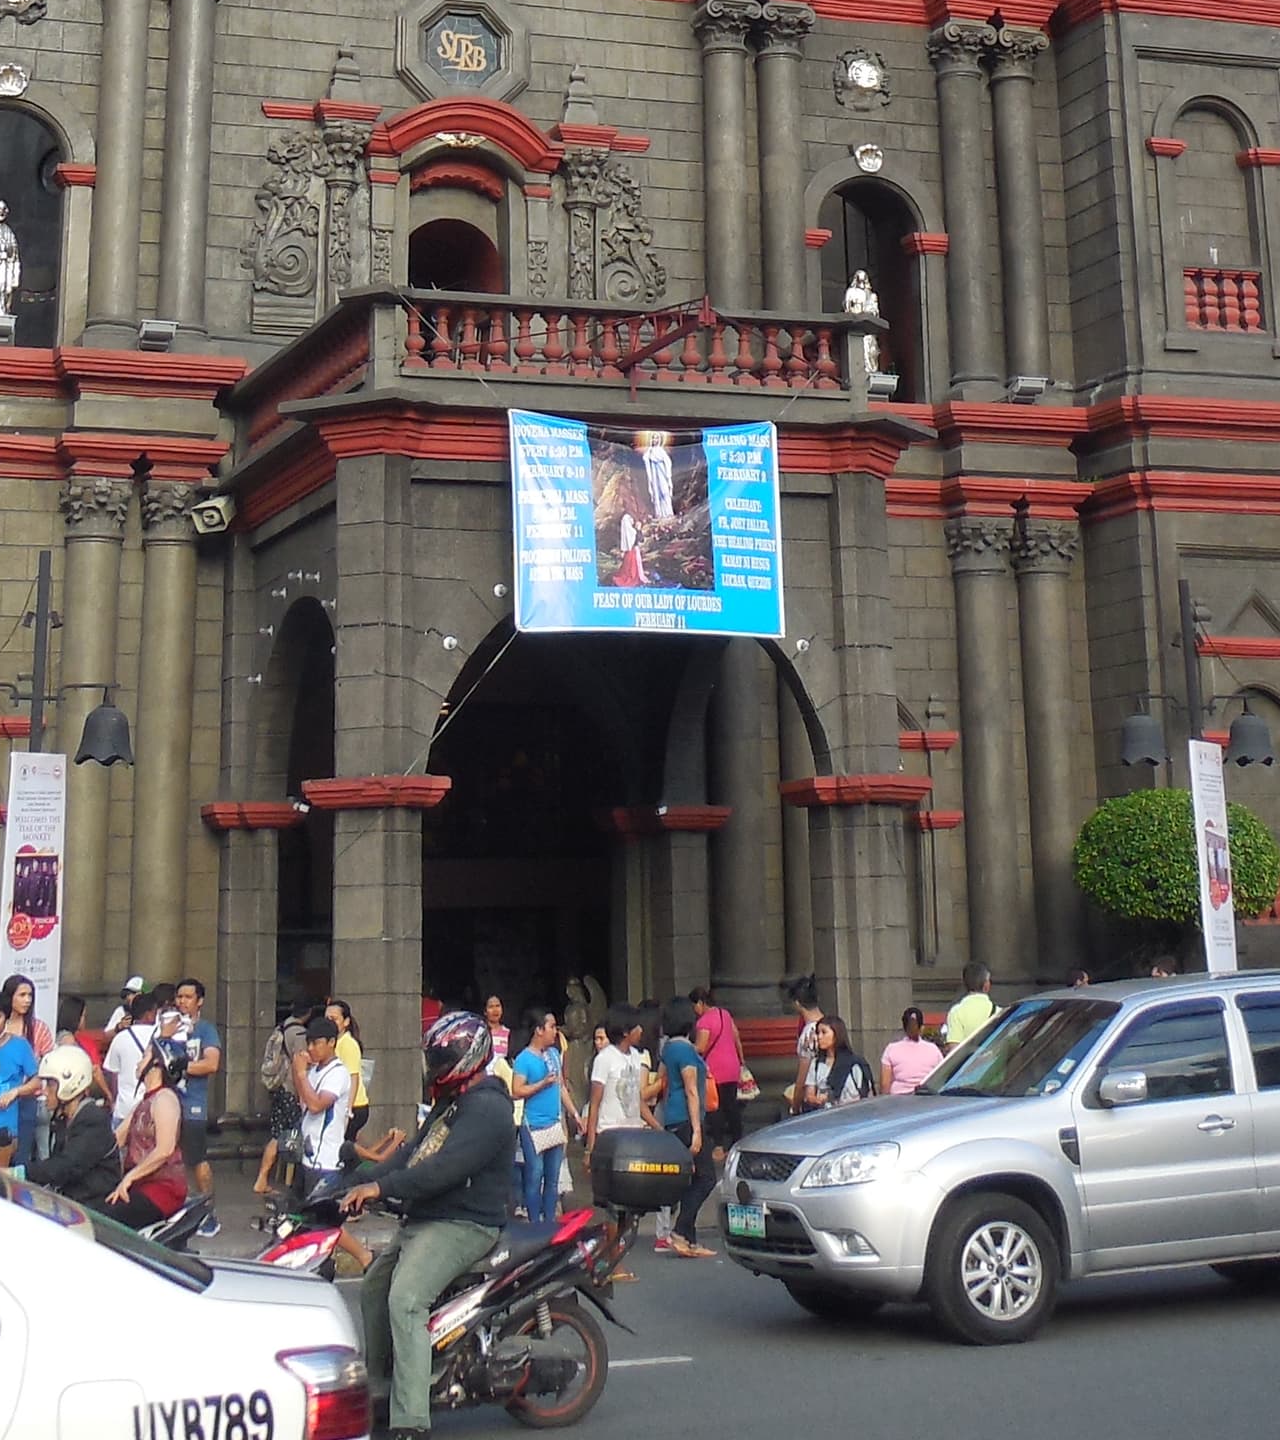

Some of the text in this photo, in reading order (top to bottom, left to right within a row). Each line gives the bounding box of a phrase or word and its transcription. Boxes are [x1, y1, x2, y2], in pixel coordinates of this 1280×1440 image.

[707, 434, 770, 448] HEALING MASS
[593, 592, 722, 612] FEAST OF OUR LADY OF LOURDES
[635, 612, 677, 628] FEBRUARY
